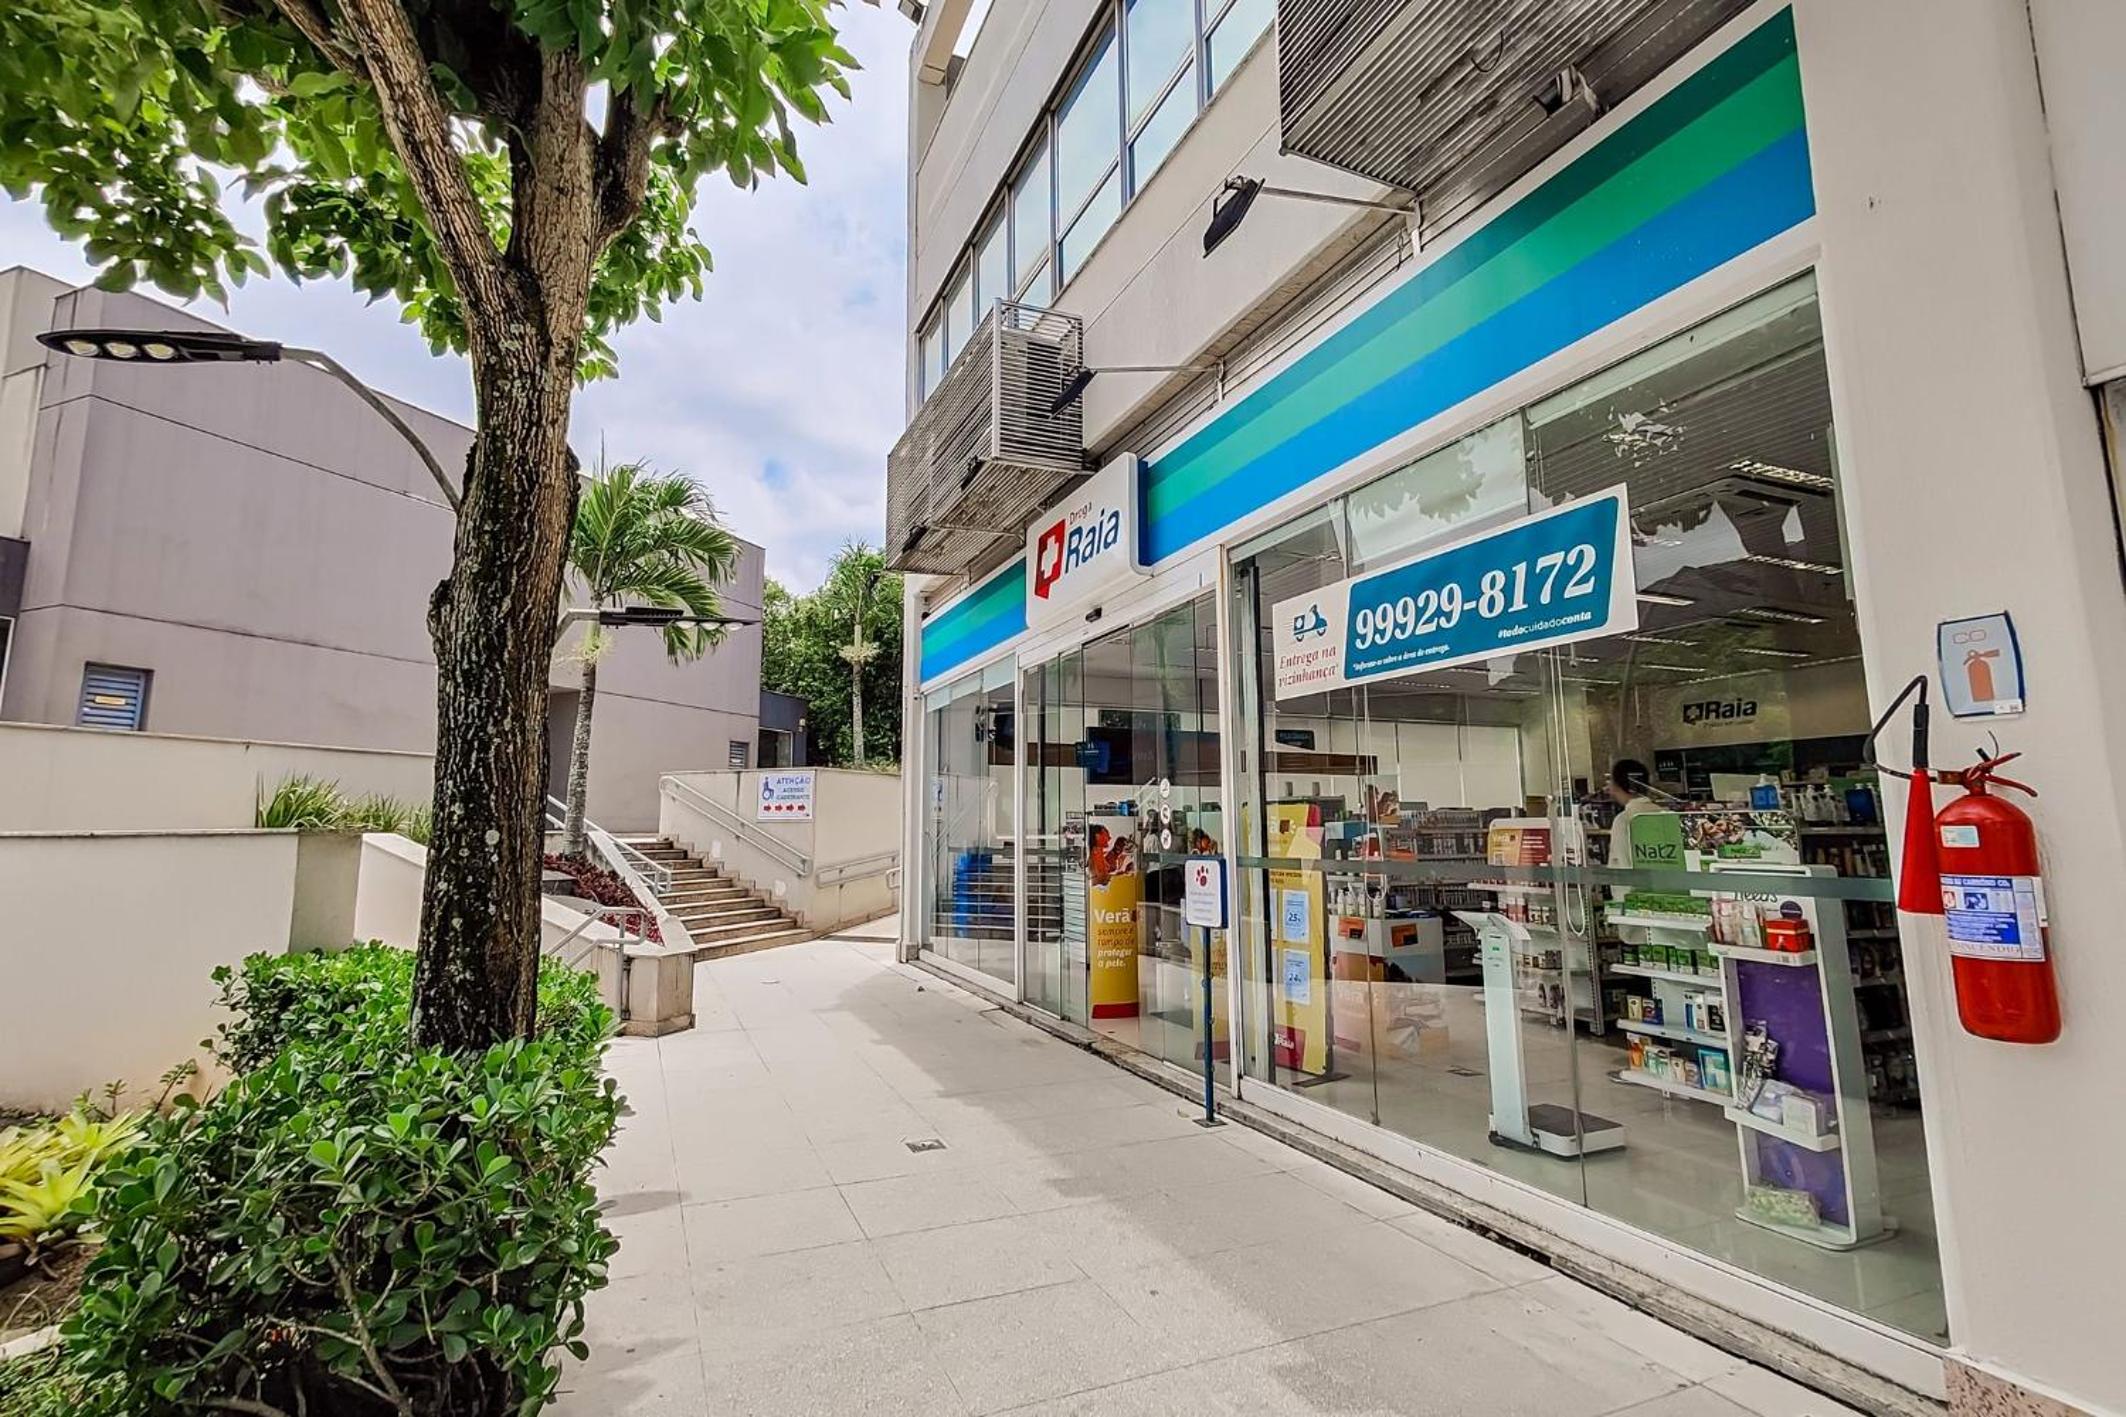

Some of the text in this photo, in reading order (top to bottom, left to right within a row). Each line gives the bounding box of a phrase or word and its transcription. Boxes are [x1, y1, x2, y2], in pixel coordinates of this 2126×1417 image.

[1070, 502, 1092, 525] Droga
[1064, 508, 1120, 574] Raia
[1355, 544, 1597, 650] 99929-8172
[1497, 611, 1592, 638] #todocuidadoconta
[1280, 646, 1336, 669] Entrega na
[1704, 698, 1758, 720] Raia
